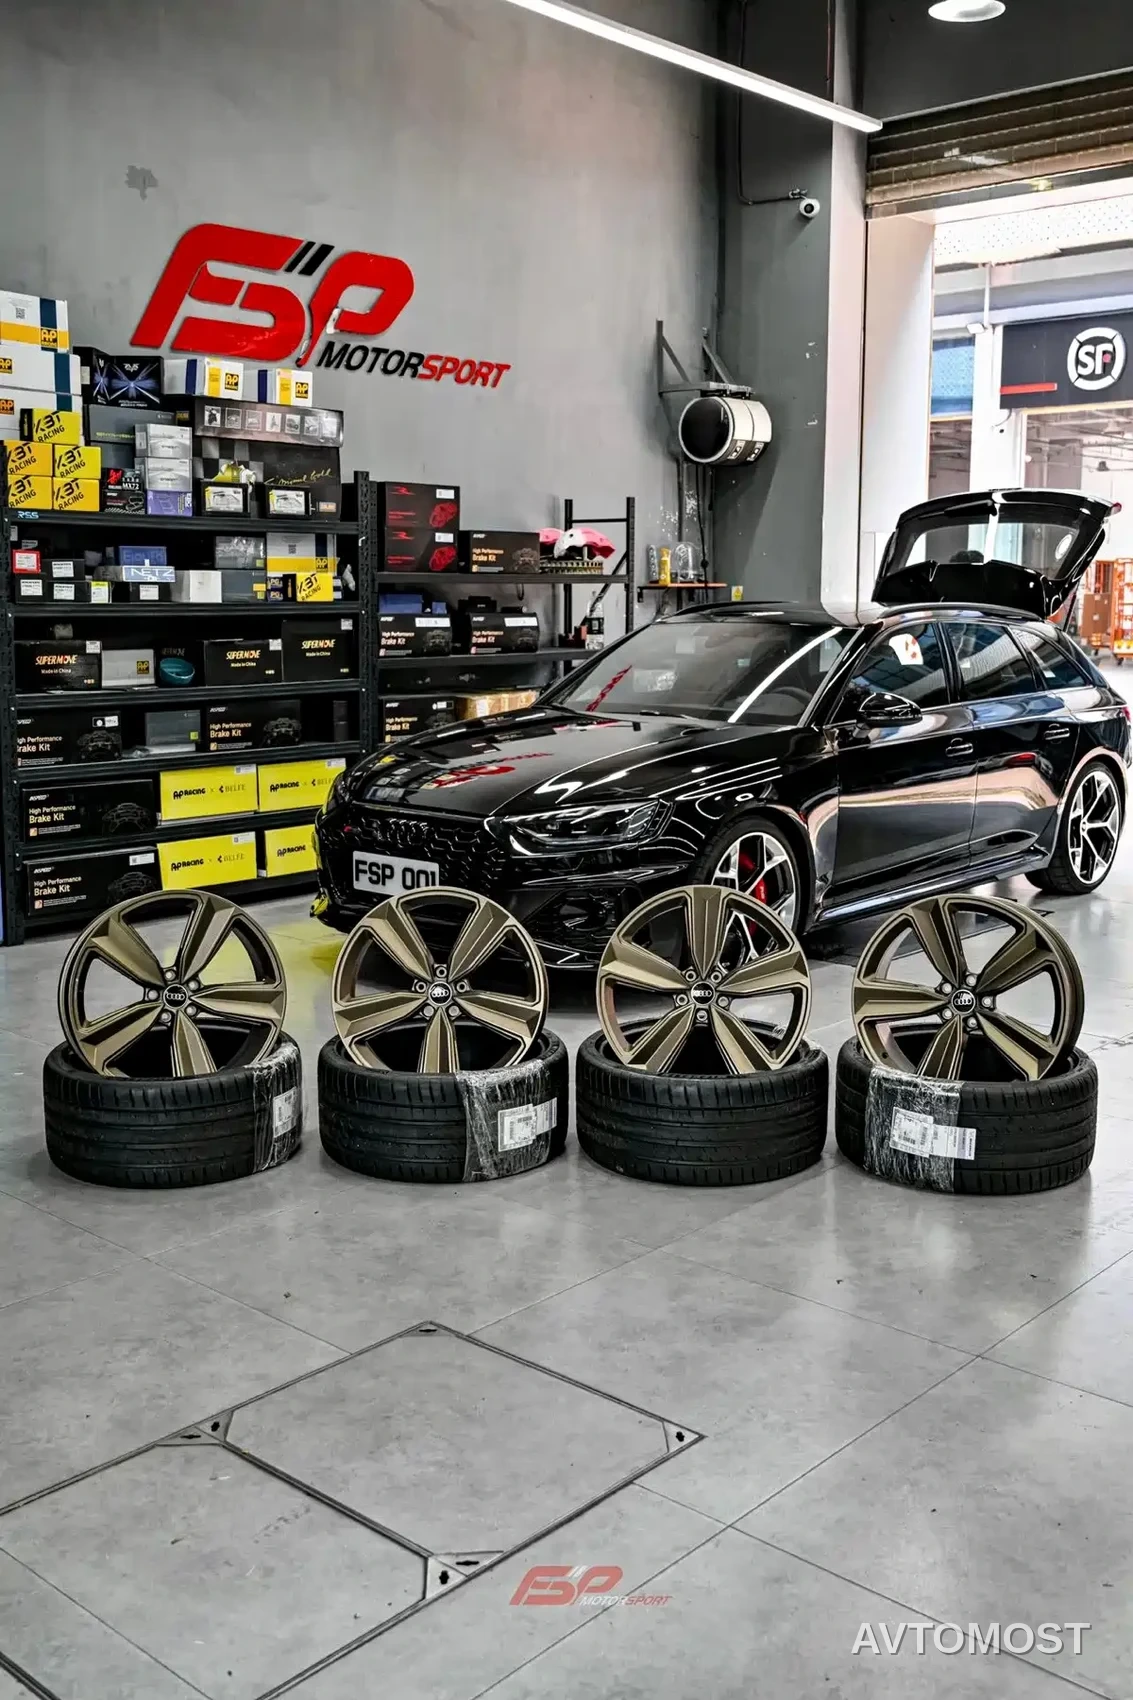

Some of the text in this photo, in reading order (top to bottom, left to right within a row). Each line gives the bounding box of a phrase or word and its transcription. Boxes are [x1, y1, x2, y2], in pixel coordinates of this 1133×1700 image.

[316, 341, 511, 388] MOTORSPORT
[38, 425, 65, 443] RACING
[9, 456, 37, 475] RACING
[60, 460, 86, 478] RACING
[9, 489, 37, 508] RACING
[58, 492, 84, 510] RACING
[210, 729, 241, 738] Brake Kit
[39, 743, 50, 751] Kit
[279, 781, 300, 789] RACING
[184, 788, 206, 796] RACING
[29, 805, 76, 815] High Performance
[29, 812, 65, 824] Brake Kit
[182, 858, 204, 867] RACING
[355, 859, 436, 890] FSP 001
[47, 876, 82, 886] Performance
[34, 884, 71, 897] Brake Kit
